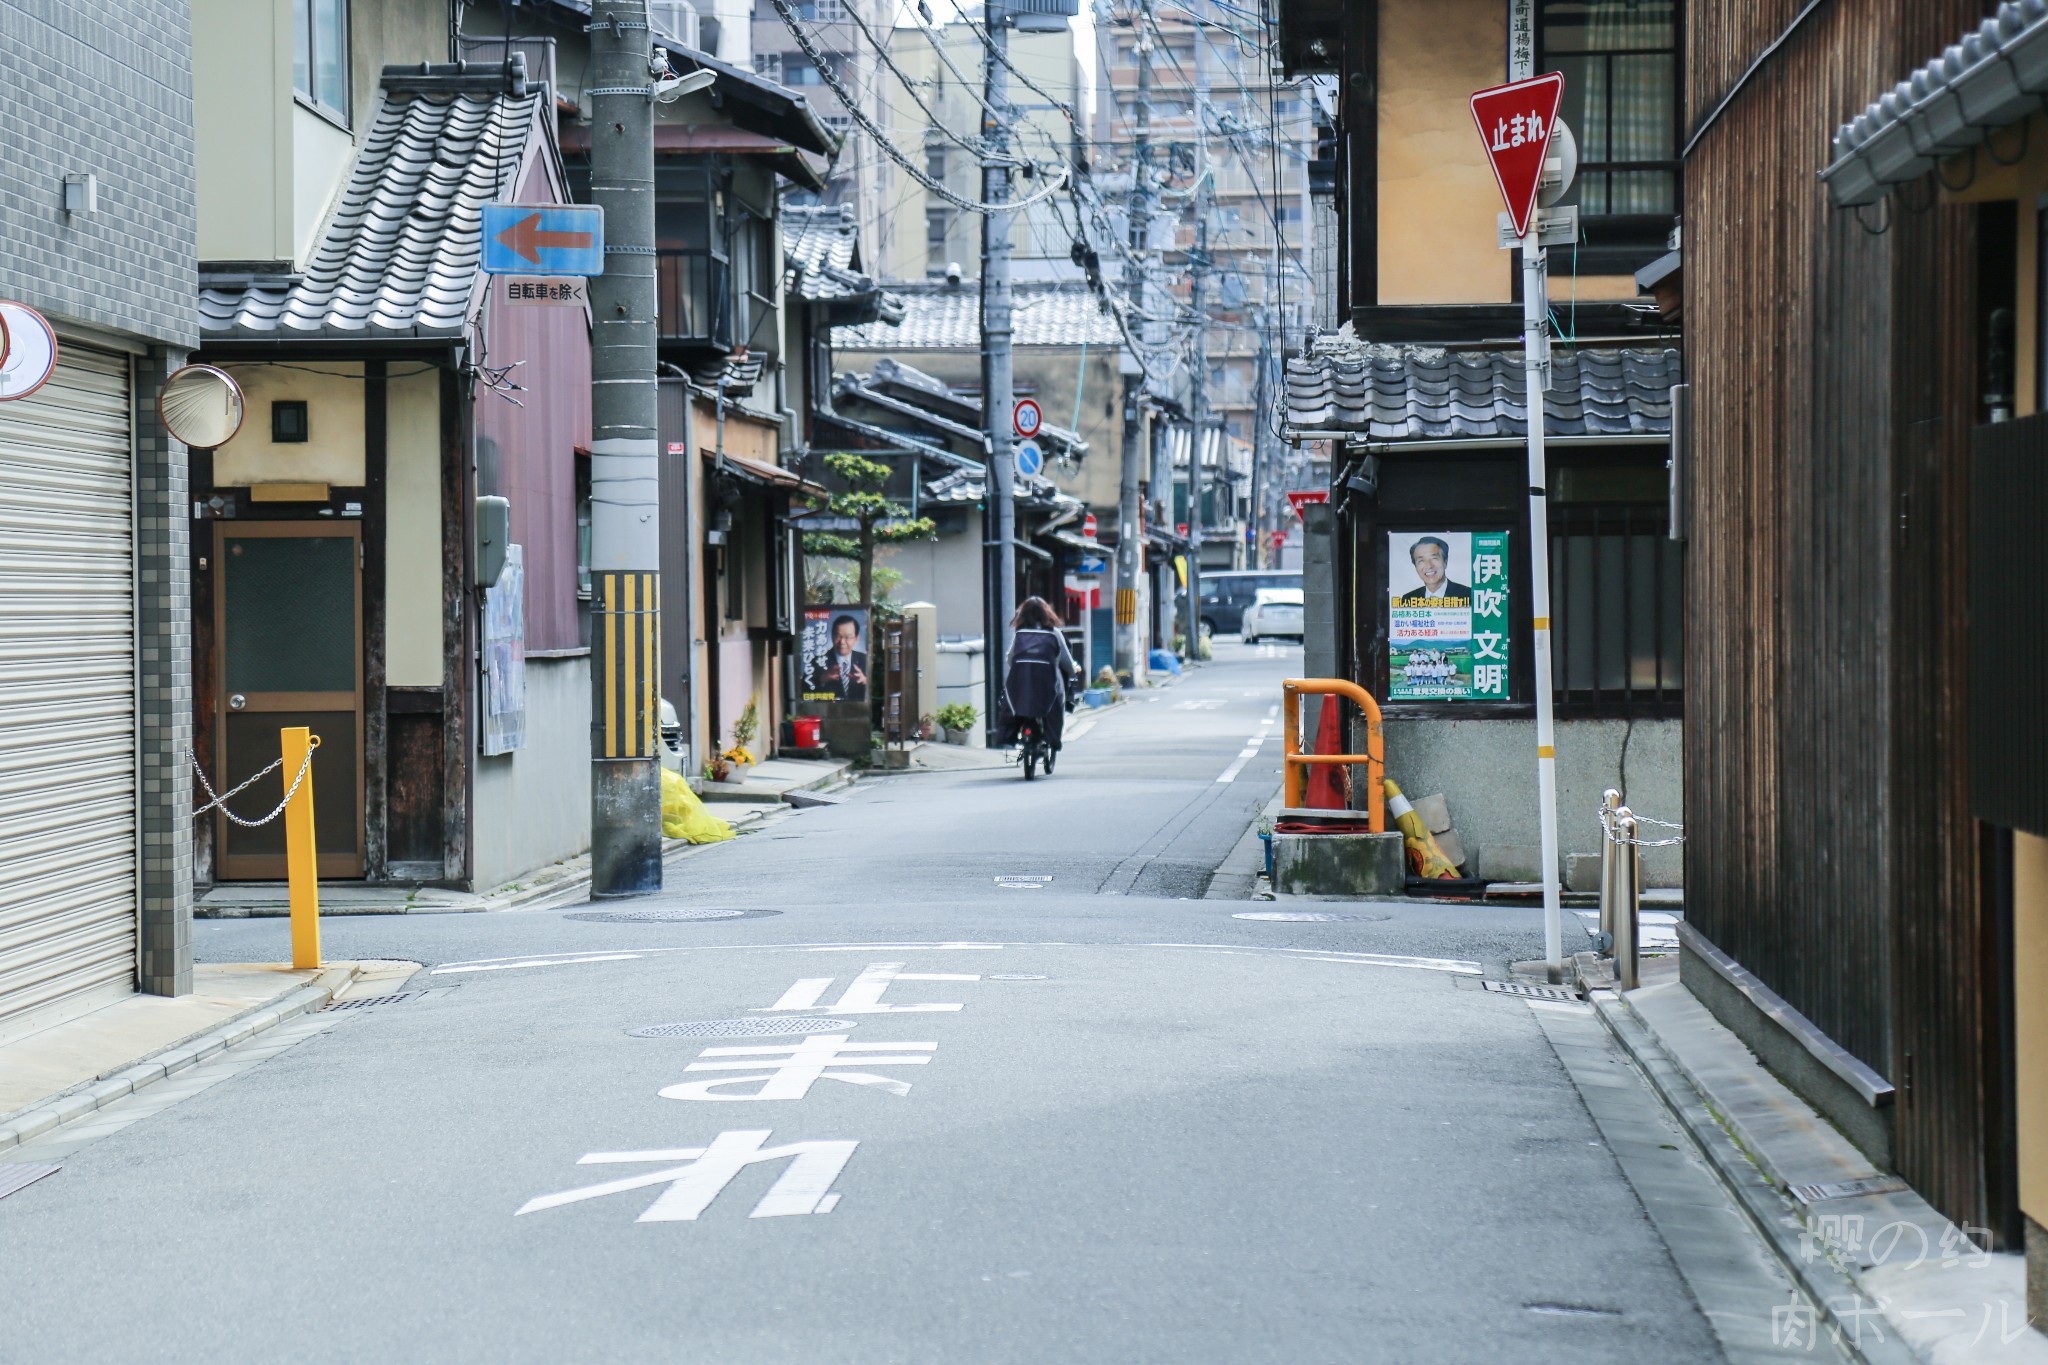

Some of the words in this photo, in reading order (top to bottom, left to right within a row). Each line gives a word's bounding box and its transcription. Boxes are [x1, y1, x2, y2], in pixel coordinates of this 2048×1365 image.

[1492, 109, 1546, 152] 止まれ
[508, 282, 583, 300] 自転車を除く
[1020, 410, 1037, 427] 20
[1391, 610, 1432, 618] 品格ある日本
[815, 621, 828, 670] 力あわせ、
[1396, 629, 1439, 637] 活力ある経済
[802, 626, 816, 691] 未来ひらく。
[514, 962, 981, 1223] 止まれ
